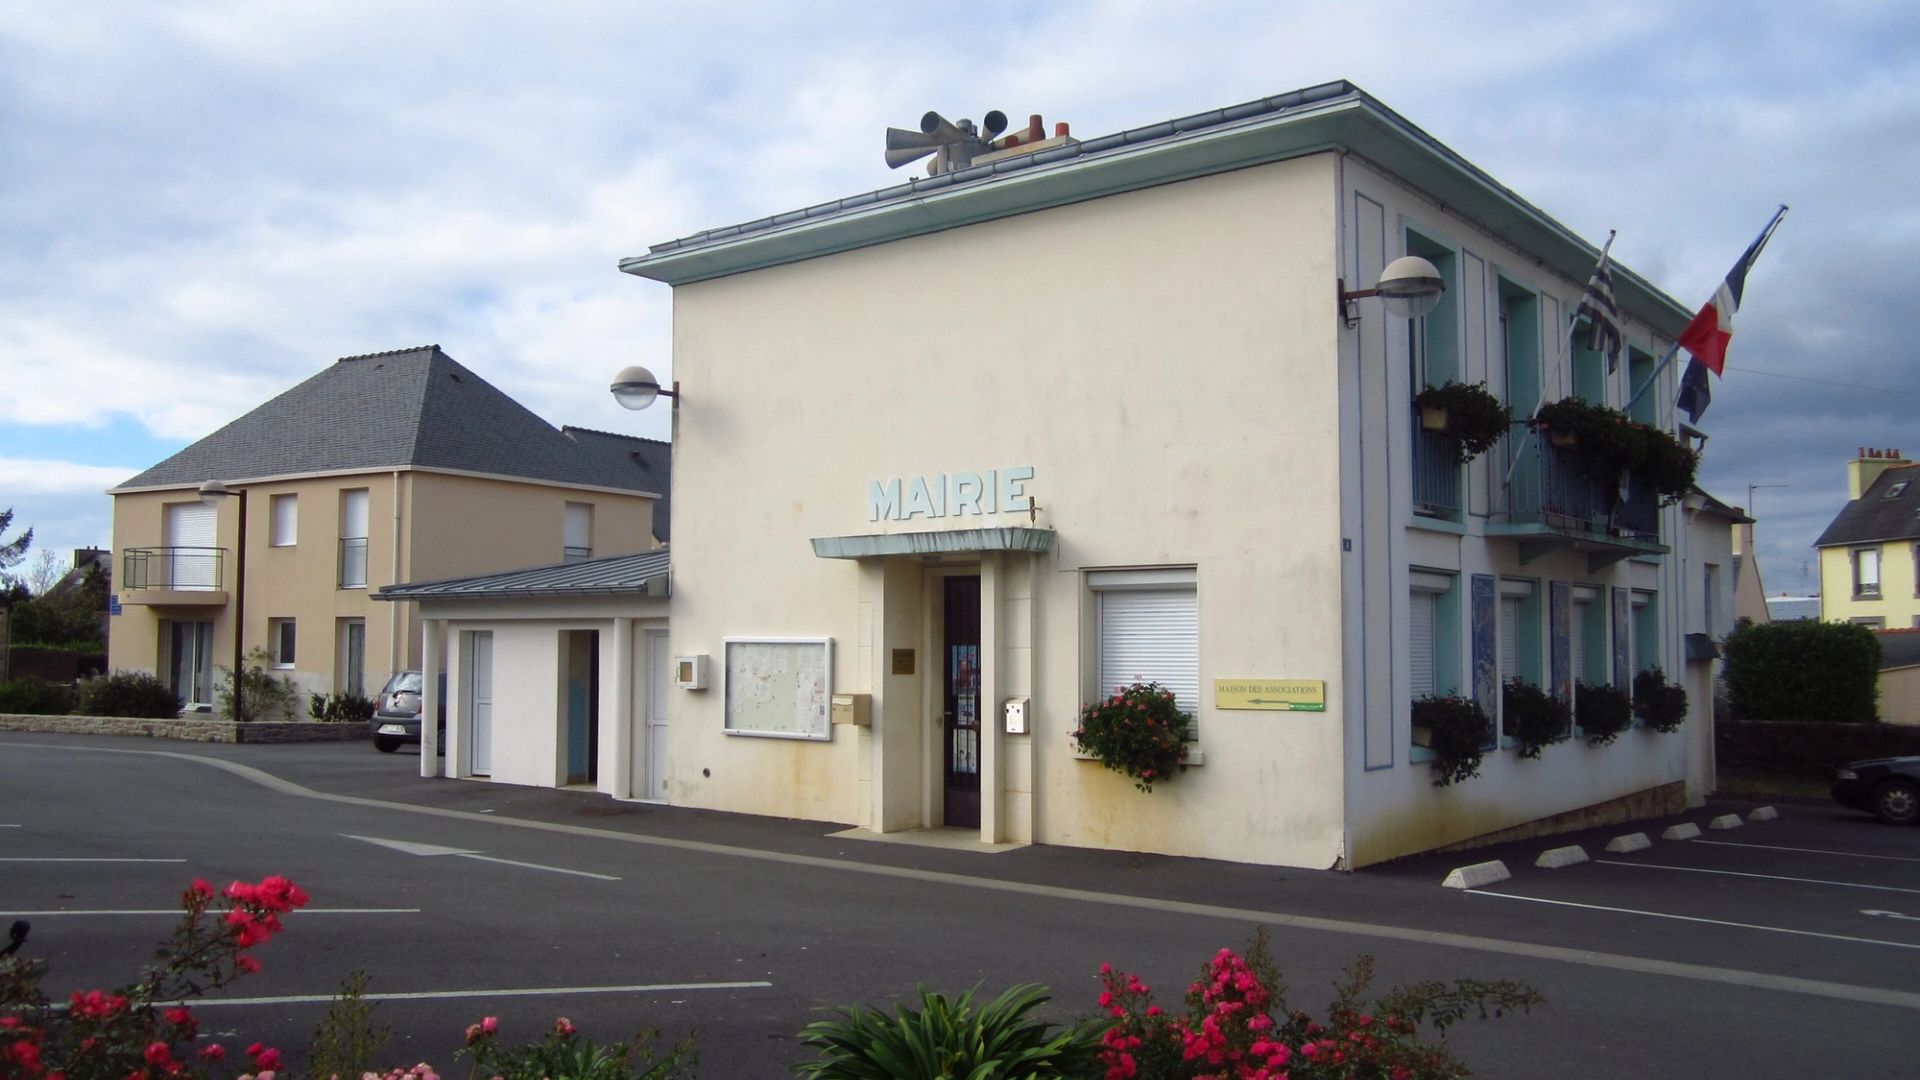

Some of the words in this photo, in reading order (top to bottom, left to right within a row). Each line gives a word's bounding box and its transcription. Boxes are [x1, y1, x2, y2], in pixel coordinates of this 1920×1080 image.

[869, 466, 1034, 522] MAIRIE
[1218, 685, 1247, 693] MAISON
[1248, 685, 1262, 693] DES
[1264, 685, 1318, 694] ASSOCIATIONS
